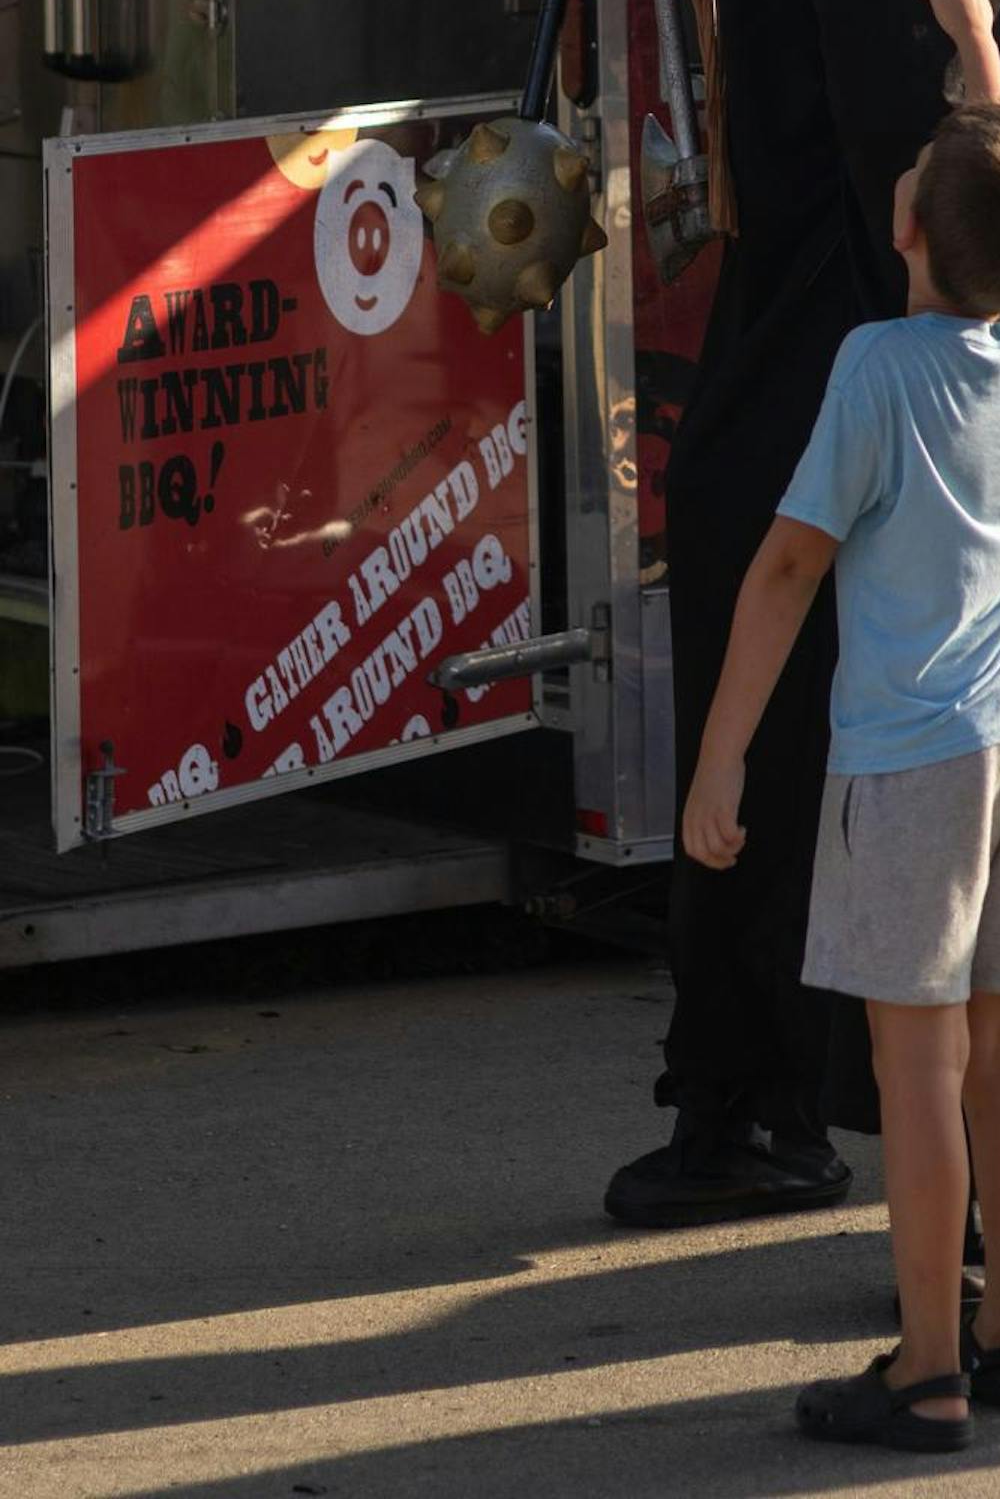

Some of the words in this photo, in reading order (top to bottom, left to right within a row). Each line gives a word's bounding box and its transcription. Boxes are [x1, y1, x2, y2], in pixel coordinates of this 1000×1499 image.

[118, 278, 297, 365] AWARD-
[117, 348, 329, 444] WINNING
[118, 440, 225, 530] BBQ!
[244, 600, 352, 732] GATHER
[348, 460, 479, 628] AROUND
[309, 597, 443, 763] AROUND
[442, 534, 513, 626] BBQ
